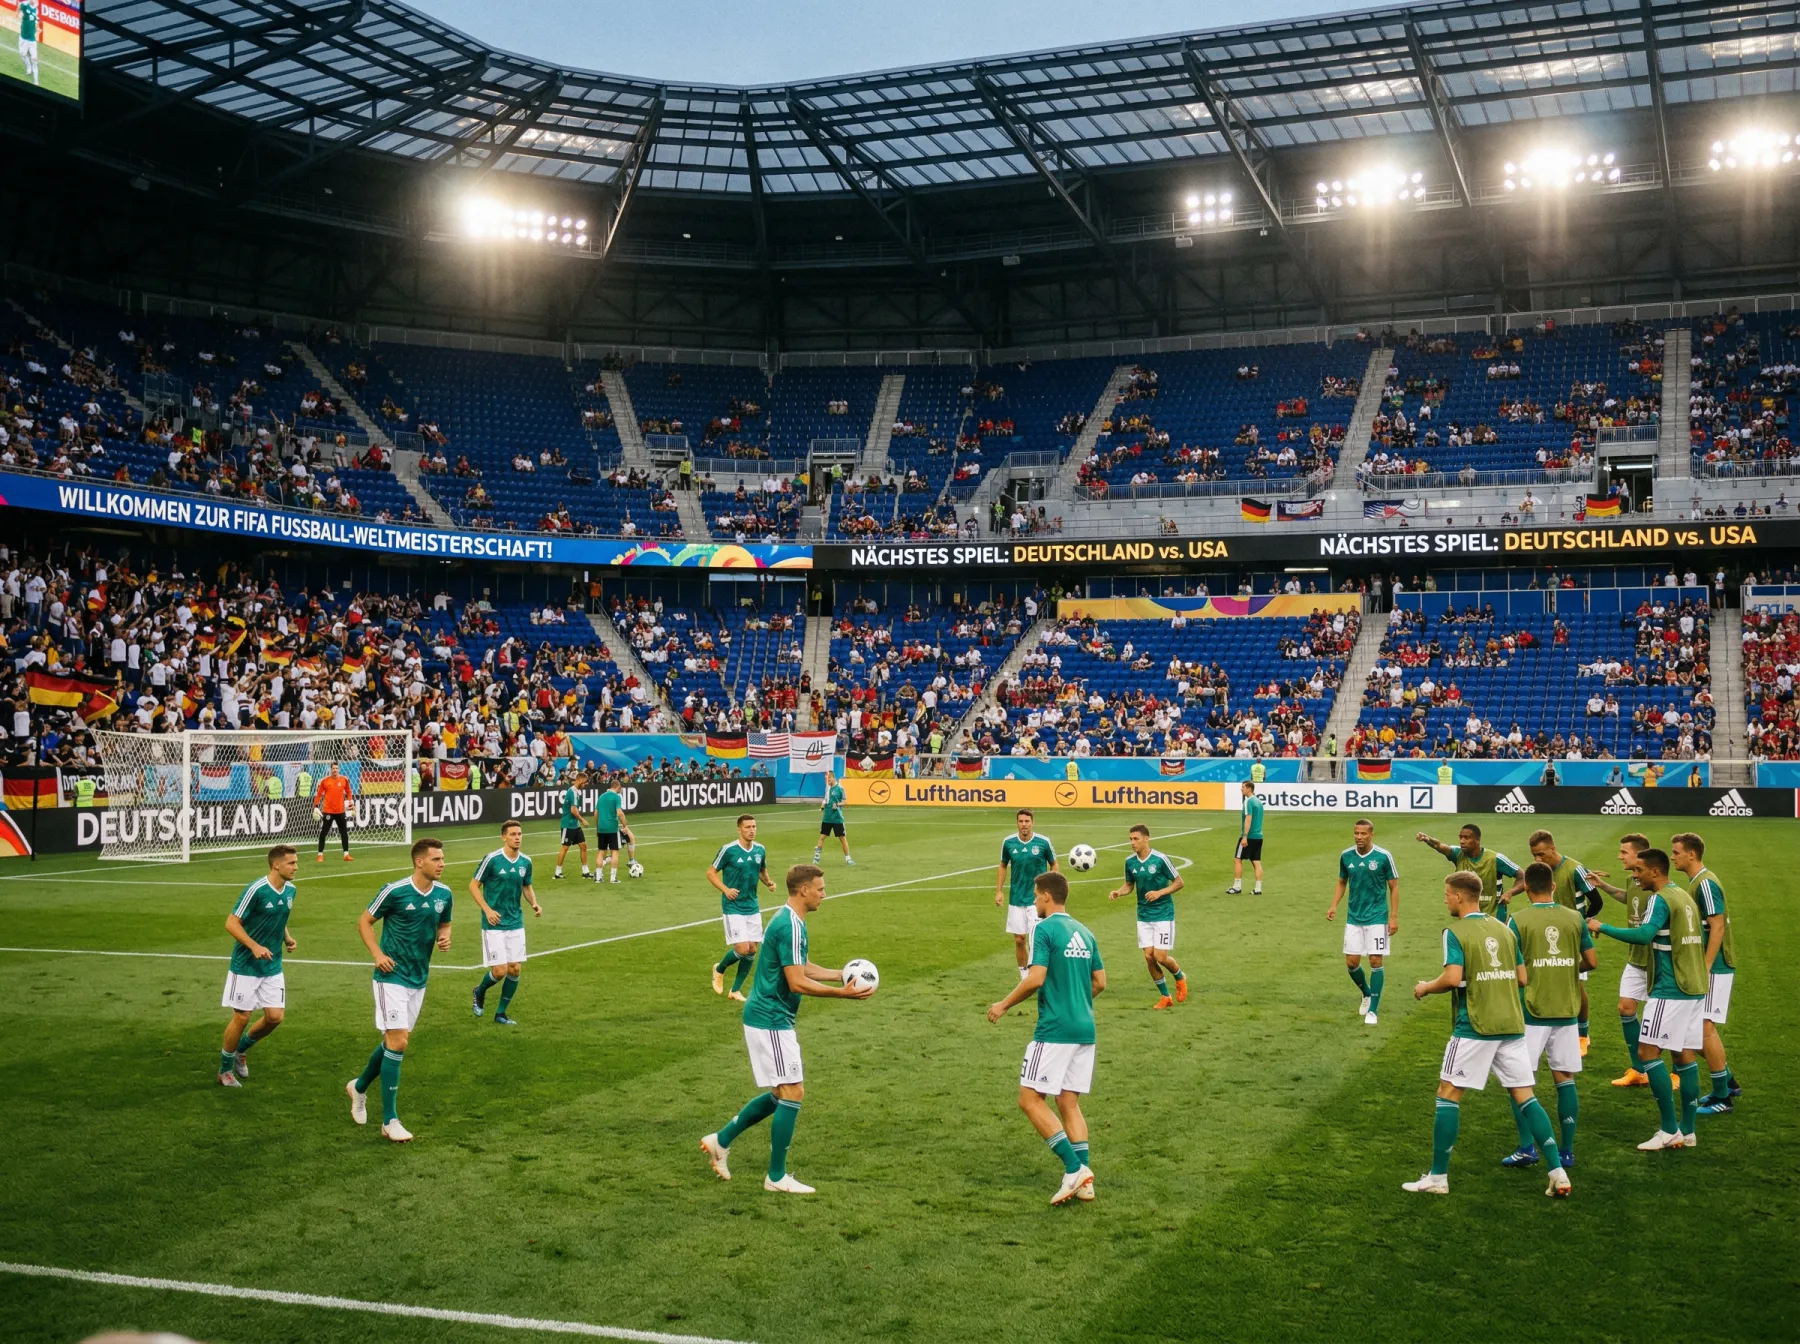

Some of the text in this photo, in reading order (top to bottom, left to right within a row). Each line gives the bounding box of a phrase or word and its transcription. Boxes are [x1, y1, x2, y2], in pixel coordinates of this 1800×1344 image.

[58, 485, 553, 559] WILLKOMMEN ZUR FIFA FUSSBALL-WELTMEISTERSCHAFT!
[1319, 525, 1758, 556] NÄCHSTES SPIEL: DEUTSCHLAND vs. USA
[851, 540, 1229, 567] NÄCHSTES SPIEL: DEUTSCHLAND vs. USA
[660, 780, 764, 808] DEUTSCHLAND
[904, 784, 1007, 803] Lufthansa
[1091, 786, 1199, 805] Lufthansa
[1242, 789, 1399, 808] eutsche Bahn
[1494, 802, 1535, 814] adidas
[1600, 803, 1643, 815] adidas
[1708, 804, 1753, 817] adidas
